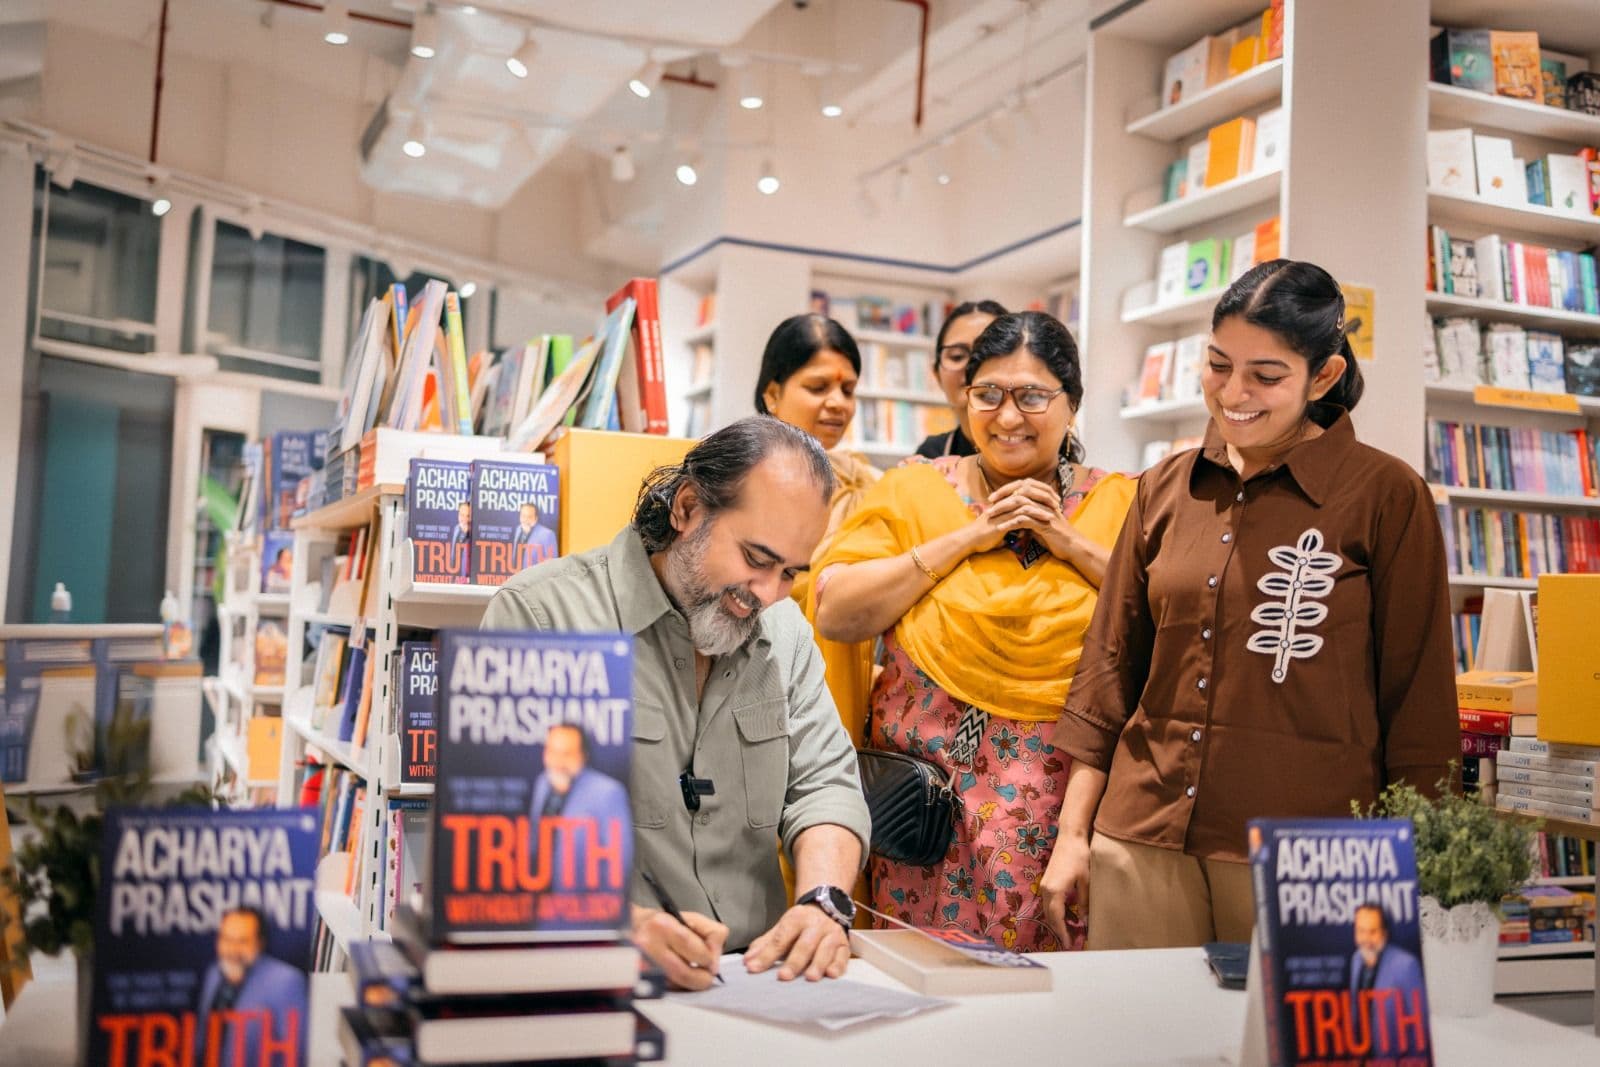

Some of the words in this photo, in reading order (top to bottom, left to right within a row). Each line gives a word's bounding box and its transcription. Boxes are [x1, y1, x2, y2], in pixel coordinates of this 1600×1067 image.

[478, 490, 557, 514] PRASHANT
[479, 469, 548, 493] ACHARYA
[450, 645, 610, 696] ACHARYA
[449, 695, 630, 745] PRASHANT
[1529, 743, 1547, 752] LOVE
[113, 826, 293, 880] ACHARYA
[442, 814, 624, 892] TRUTH
[1276, 837, 1398, 881] ACHARYA
[110, 877, 314, 937] PRASHANT
[1278, 879, 1416, 926] PRASHANT
[98, 1006, 299, 1067] TRUTH
[1284, 987, 1427, 1057] TRUTH
